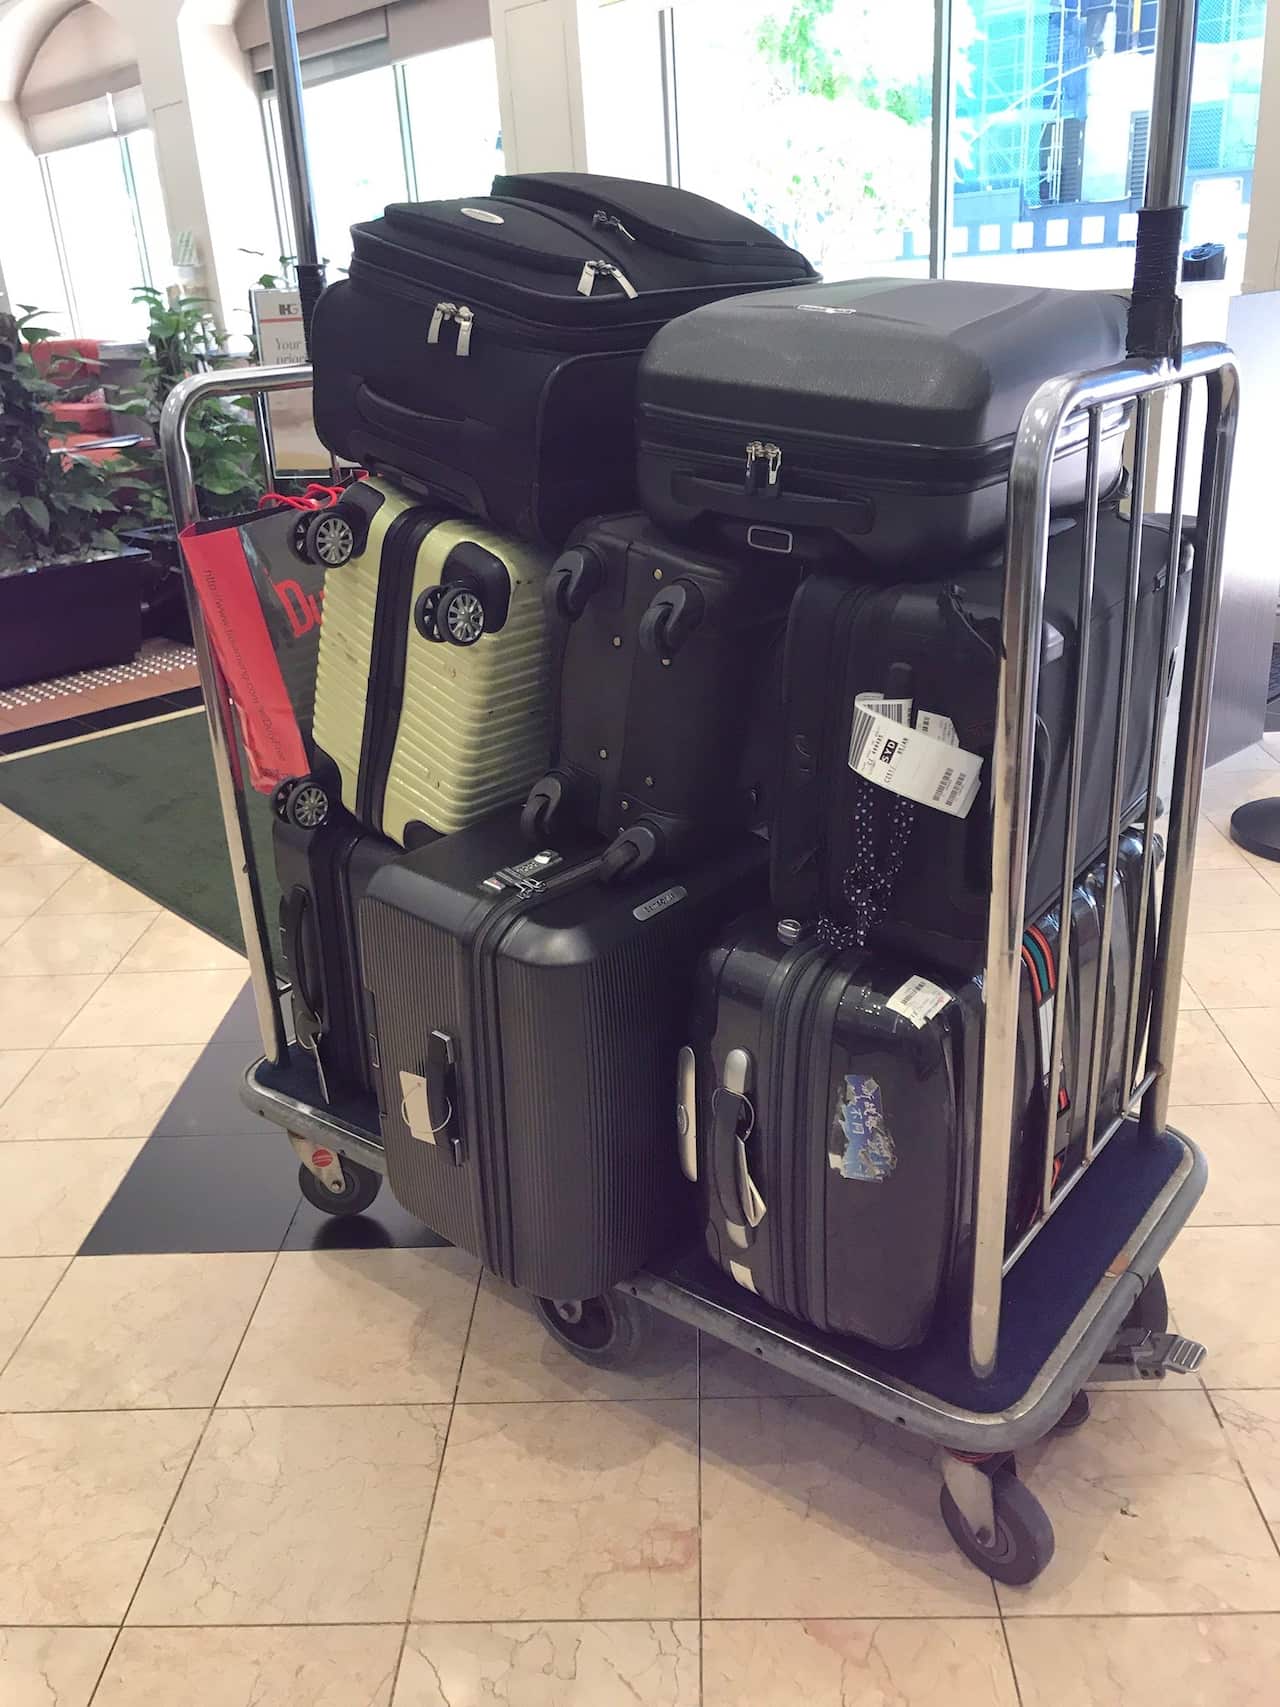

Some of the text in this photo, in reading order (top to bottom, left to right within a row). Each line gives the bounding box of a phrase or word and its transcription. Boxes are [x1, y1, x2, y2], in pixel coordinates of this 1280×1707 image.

[278, 303, 298, 315] IHG
[275, 337, 303, 350] Your
[881, 740, 897, 764] SYD
